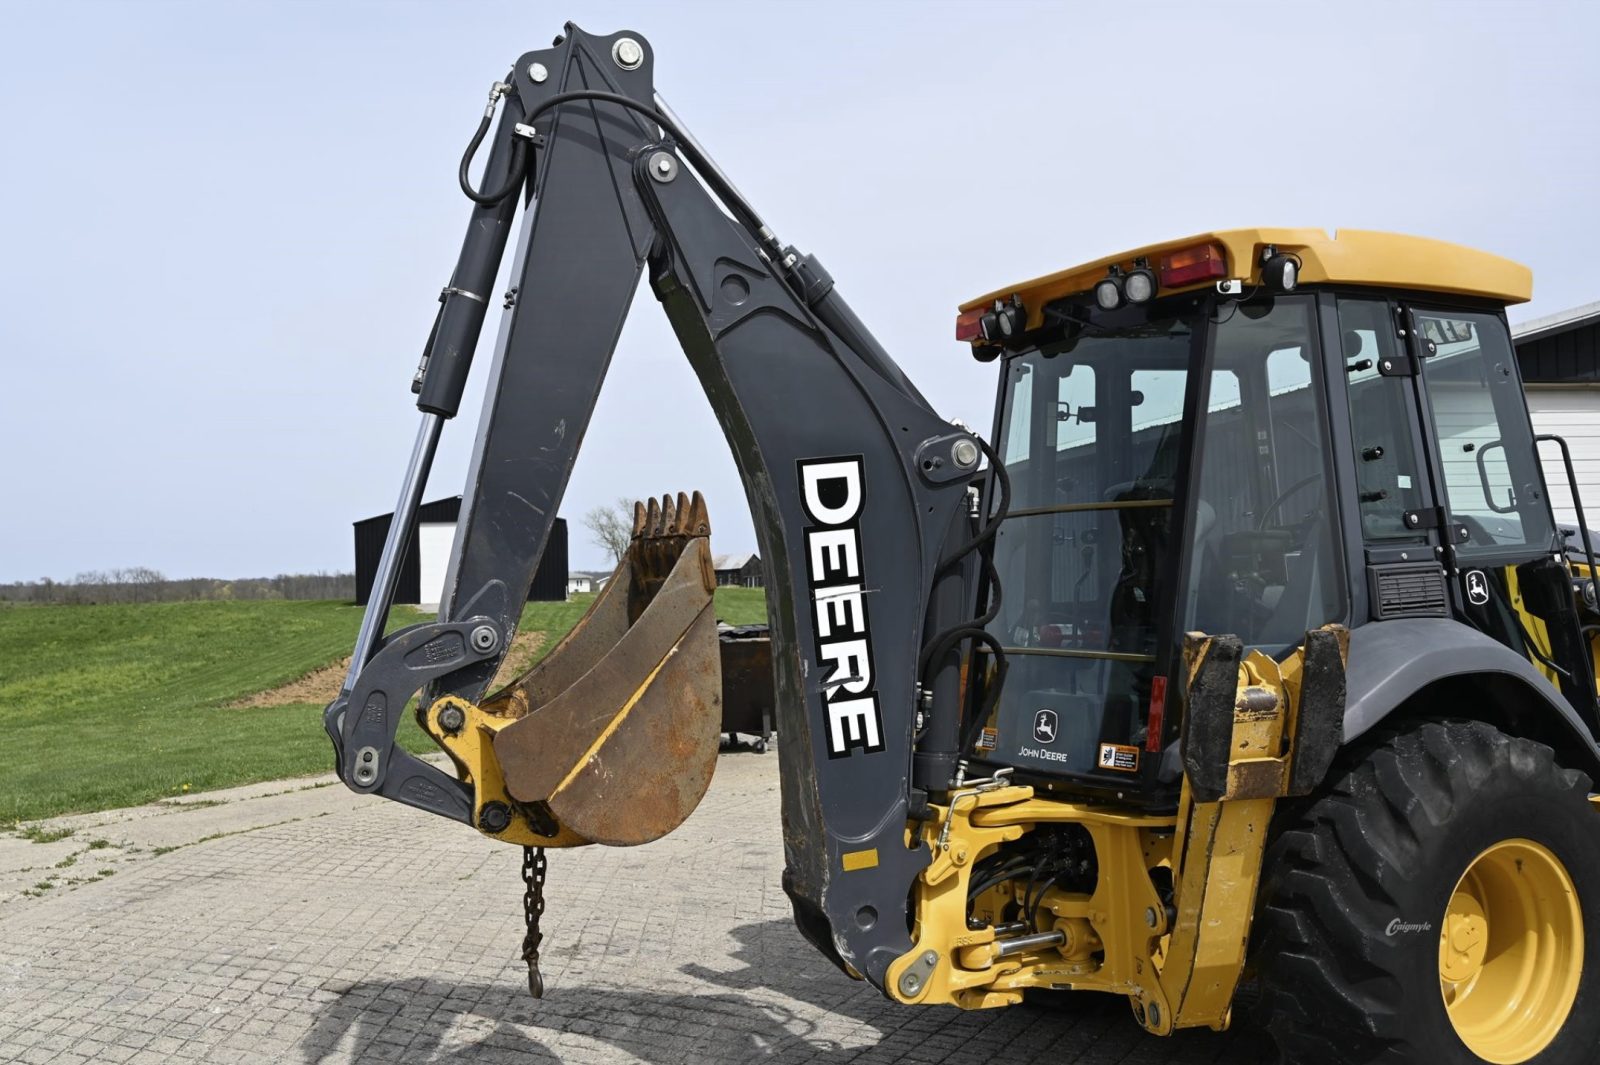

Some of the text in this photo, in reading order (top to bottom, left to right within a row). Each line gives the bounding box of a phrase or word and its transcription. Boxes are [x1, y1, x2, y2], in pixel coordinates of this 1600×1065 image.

[802, 460, 881, 753] DEERE
[1018, 745, 1068, 763] JOHN DEERE
